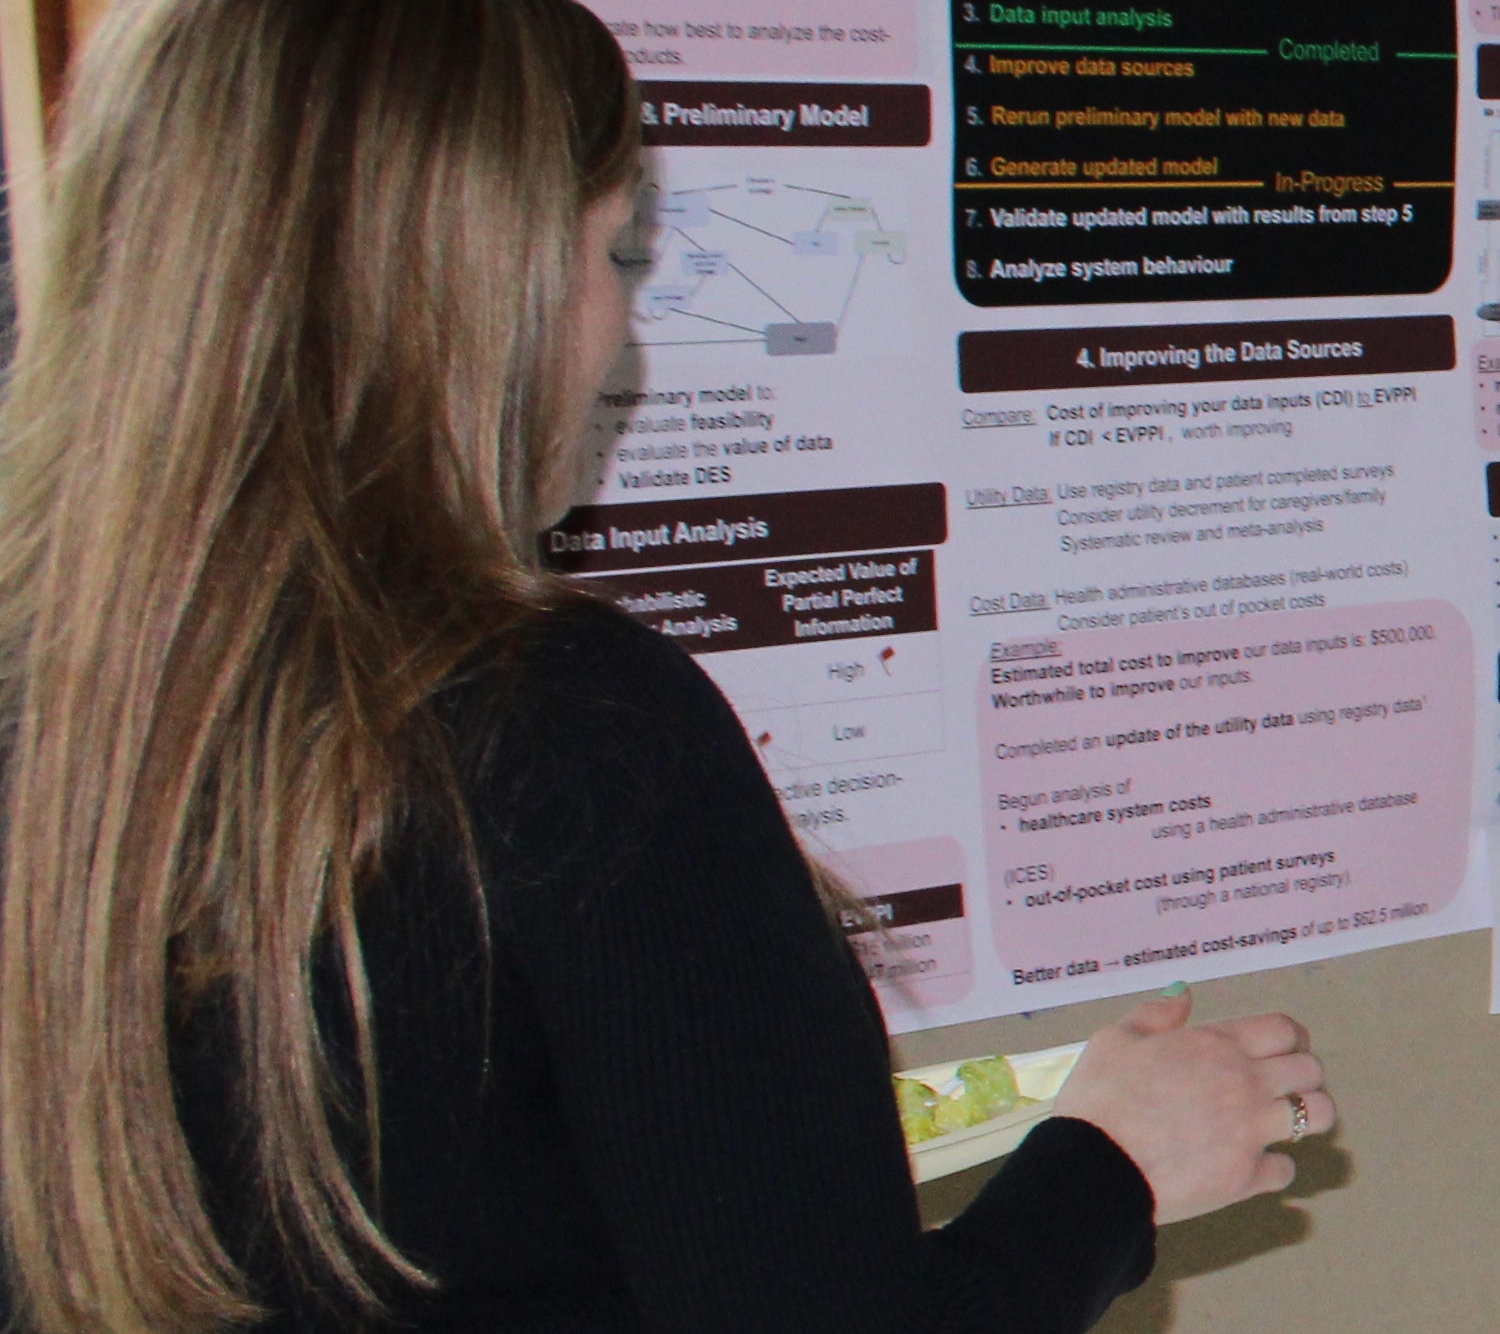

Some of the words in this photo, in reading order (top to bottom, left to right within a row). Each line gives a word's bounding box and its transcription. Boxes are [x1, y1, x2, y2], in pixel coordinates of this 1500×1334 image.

[963, 2, 979, 22] 3.
[989, 3, 1035, 24] Data
[1041, 6, 1091, 28] input
[1095, 7, 1172, 31] analysis
[1278, 37, 1380, 64] Completed
[964, 54, 983, 73] 4.
[989, 54, 1070, 78] Improve
[1075, 56, 1116, 75] data
[1120, 61, 1194, 77] sources
[662, 101, 795, 131] Preliminary
[799, 103, 868, 126] Model
[967, 106, 983, 125] 5.
[990, 105, 1049, 125] Rerun
[1054, 106, 1159, 130] preliminary
[1164, 108, 1220, 126] model
[1224, 108, 1263, 126] with
[1267, 112, 1303, 126] new
[1307, 109, 1344, 127] data
[965, 157, 983, 176] 6.
[990, 156, 1076, 176] Generate
[1082, 157, 1157, 178] updated
[1162, 157, 1217, 175] model
[1275, 170, 1384, 197] In-Progress
[965, 208, 982, 225] 7.
[989, 207, 1068, 228] Validate
[1072, 206, 1148, 231] updated
[1151, 206, 1209, 226] model
[1211, 205, 1250, 224] with
[1253, 204, 1315, 224] results
[1317, 203, 1358, 223] from
[1360, 205, 1399, 226] step
[1401, 203, 1413, 222] 5
[966, 259, 981, 278] 8.
[989, 257, 1067, 284] Analyze
[1070, 258, 1138, 282] system
[1142, 254, 1234, 275] behaviour
[1075, 347, 1095, 368] 4.
[1099, 343, 1201, 372] Improving
[1203, 342, 1237, 363] the
[1239, 339, 1283, 362] Data
[1286, 336, 1363, 360] Sources
[1046, 402, 1084, 421] Cost
[1088, 402, 1103, 419] of
[1107, 399, 1187, 421] improving
[1191, 399, 1227, 417] your
[1231, 395, 1263, 411] data
[1267, 393, 1311, 412] inputs
[1315, 389, 1353, 409] (CDI)
[1357, 391, 1372, 408] to
[1371, 386, 1416, 407] EVPPI
[962, 404, 1037, 432] Compare:
[1064, 428, 1093, 447] CDI
[1101, 430, 1111, 442] <
[620, 470, 688, 489] Validate
[695, 465, 731, 484] DES
[608, 523, 670, 554] Input
[673, 515, 769, 549] Analysis
[763, 561, 846, 591] Expected
[847, 558, 896, 580] Value
[898, 556, 917, 576] of
[781, 589, 838, 612] Partial
[841, 584, 903, 607] Perfect
[660, 612, 738, 640] Analysis
[793, 611, 893, 637] Information
